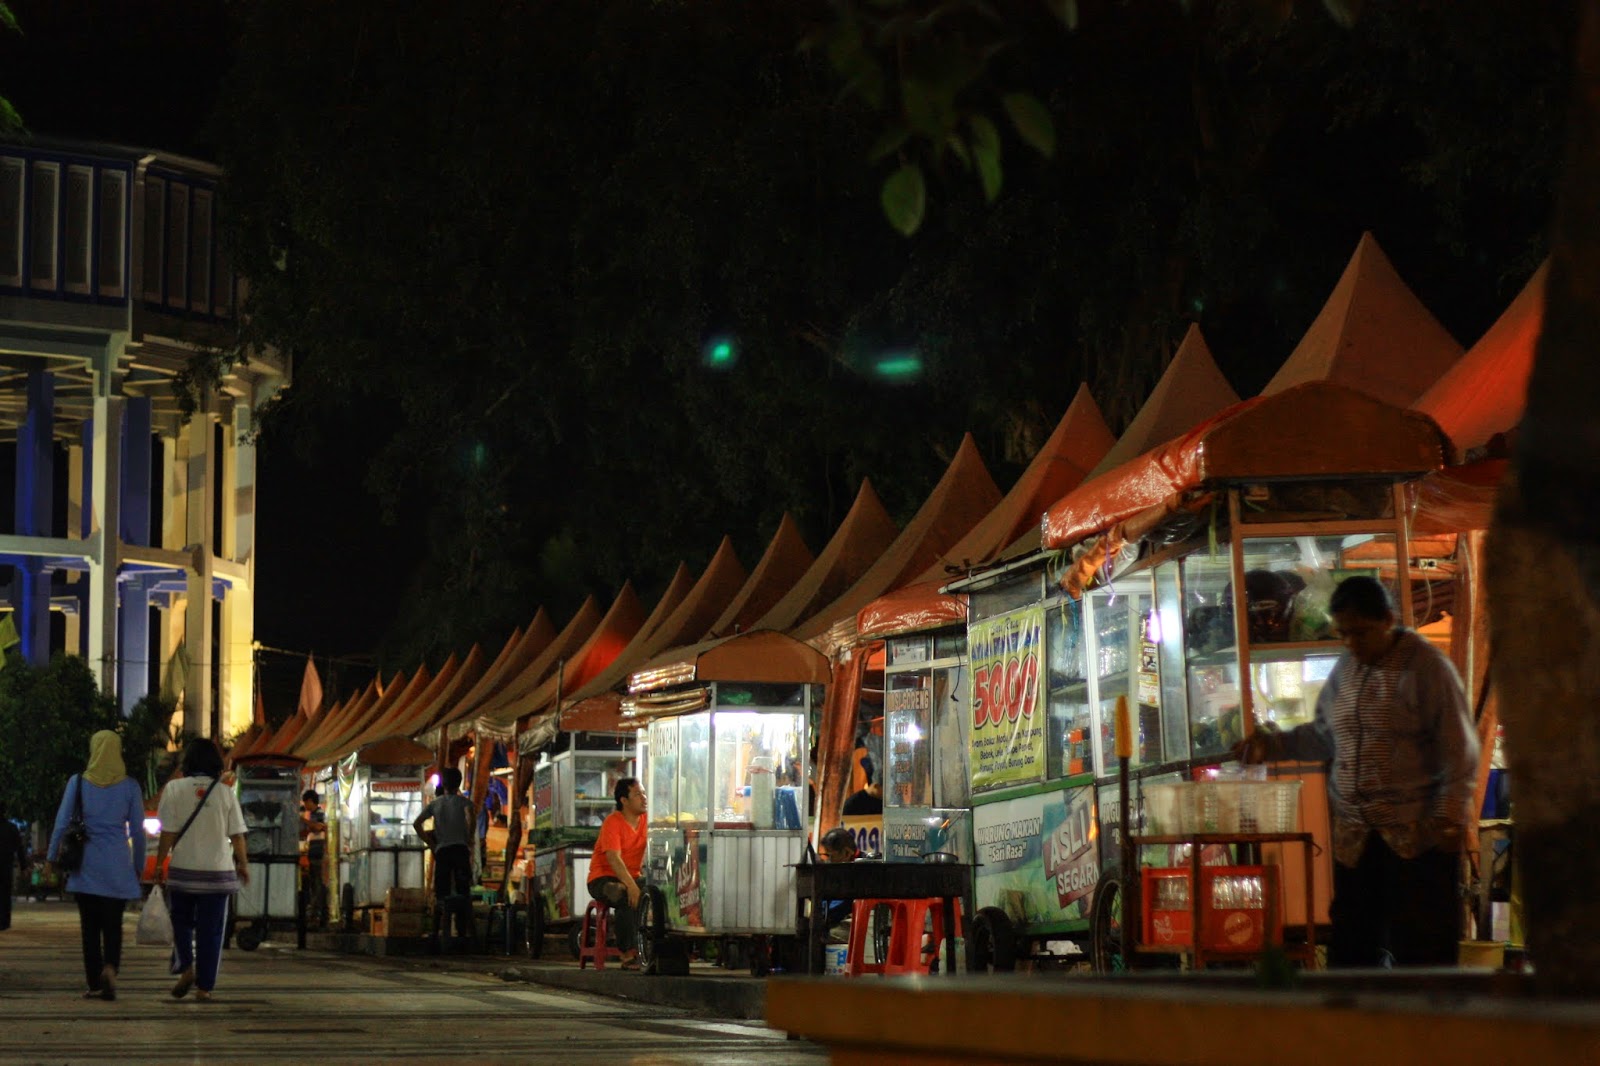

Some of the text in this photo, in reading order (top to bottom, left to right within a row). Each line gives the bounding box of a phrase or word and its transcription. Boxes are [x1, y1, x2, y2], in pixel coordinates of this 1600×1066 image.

[902, 689, 929, 710] GORENG
[974, 651, 1040, 730] 5000
[1022, 727, 1042, 739] Kapung
[977, 817, 1041, 846] WARUNG MAKAN
[1050, 809, 1088, 872] ASLI
[1006, 840, 1027, 860] Rasa"
